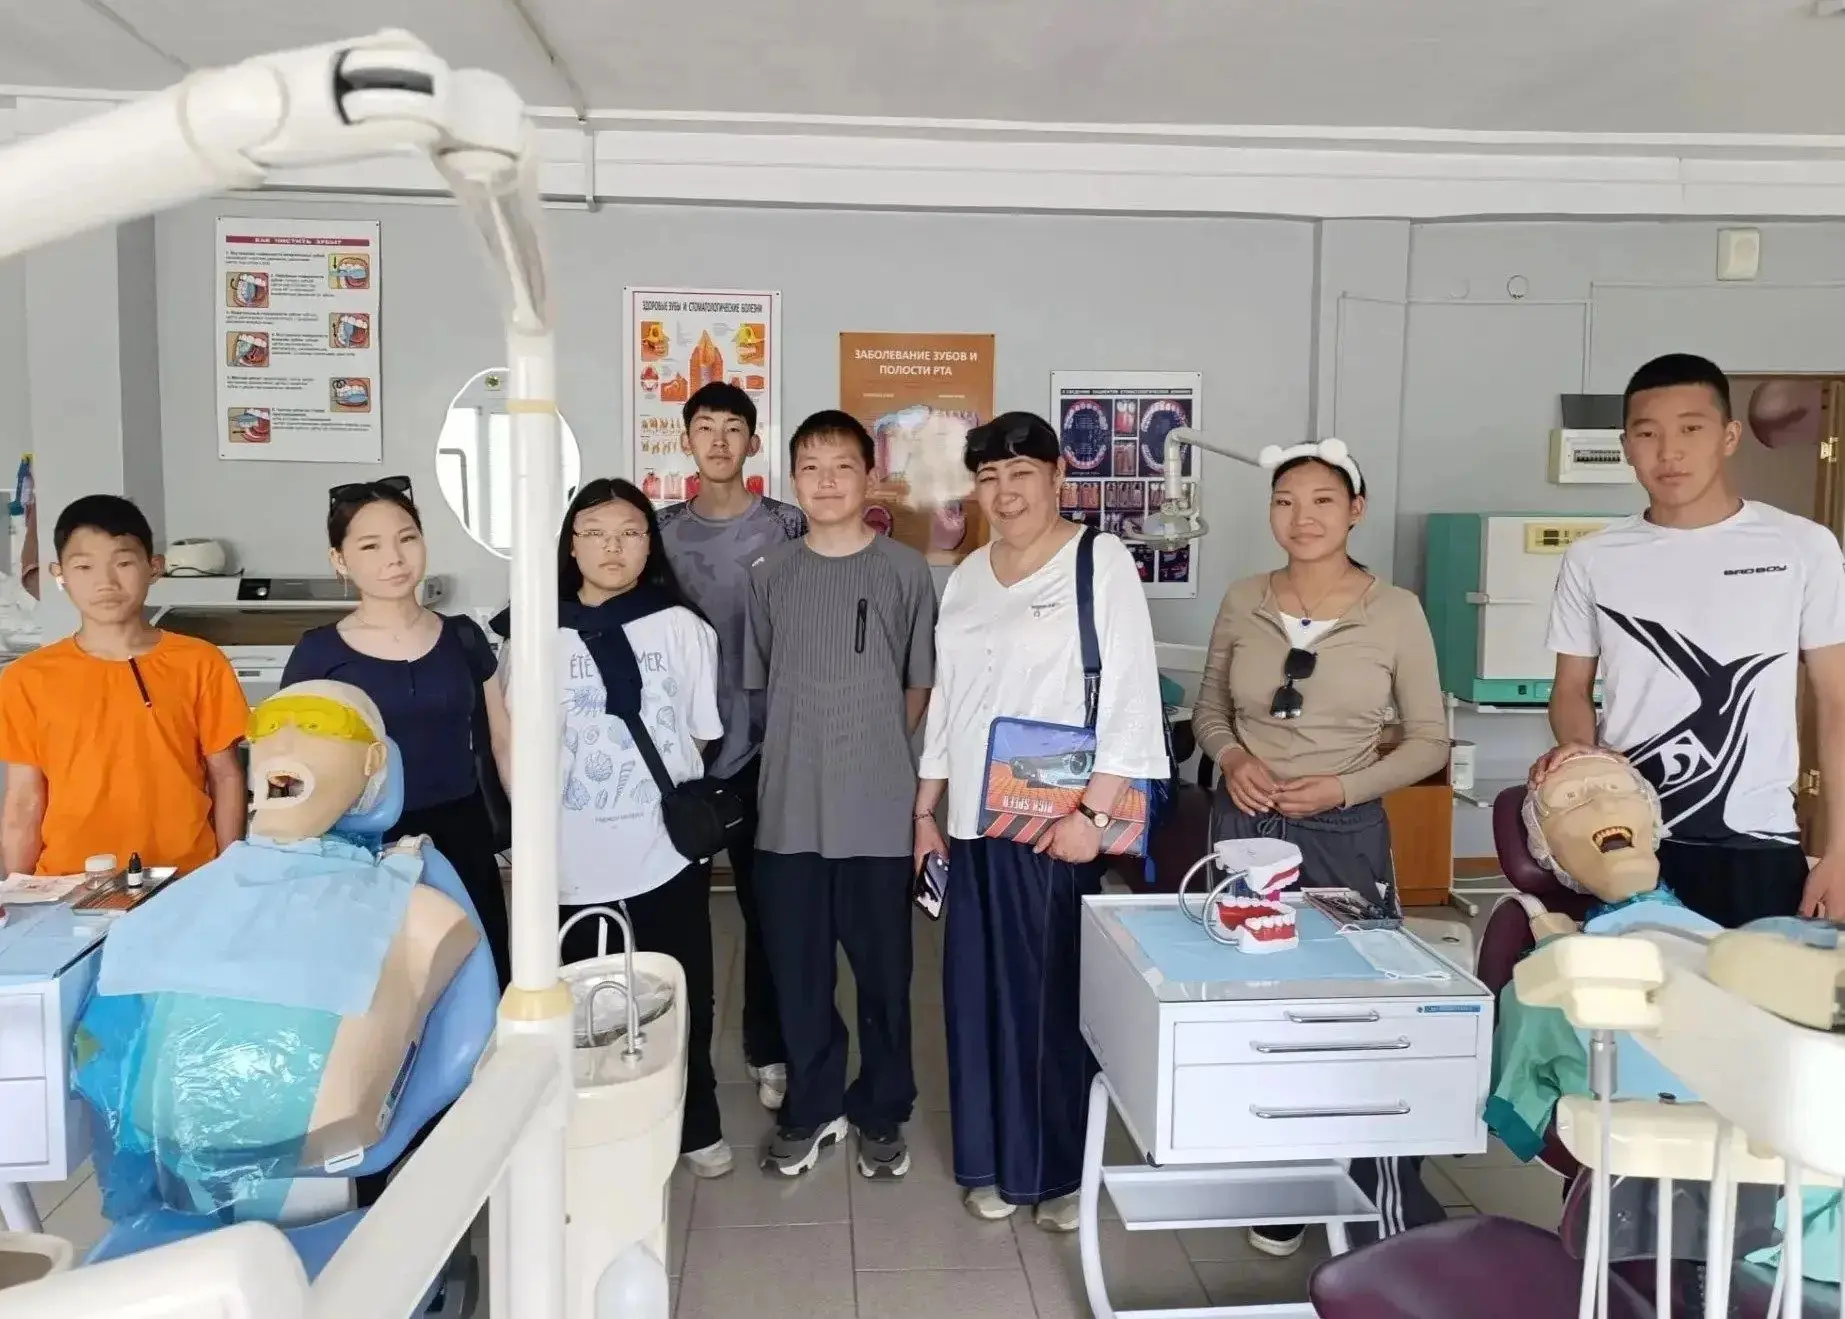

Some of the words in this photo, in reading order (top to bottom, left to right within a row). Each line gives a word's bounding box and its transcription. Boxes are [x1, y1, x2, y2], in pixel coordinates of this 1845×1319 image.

[682, 301, 687, 312] И
[688, 301, 740, 313] СТОМАТОЛОГИЧЕСКИЕ
[854, 349, 930, 361] ЗАБОЛЕВАНИЕ
[933, 350, 967, 361] ЗУБОВ
[969, 351, 978, 361] И
[879, 365, 931, 375] ПОЛОСТИ
[933, 366, 953, 376] РТА
[1755, 565, 1787, 573] BOY
